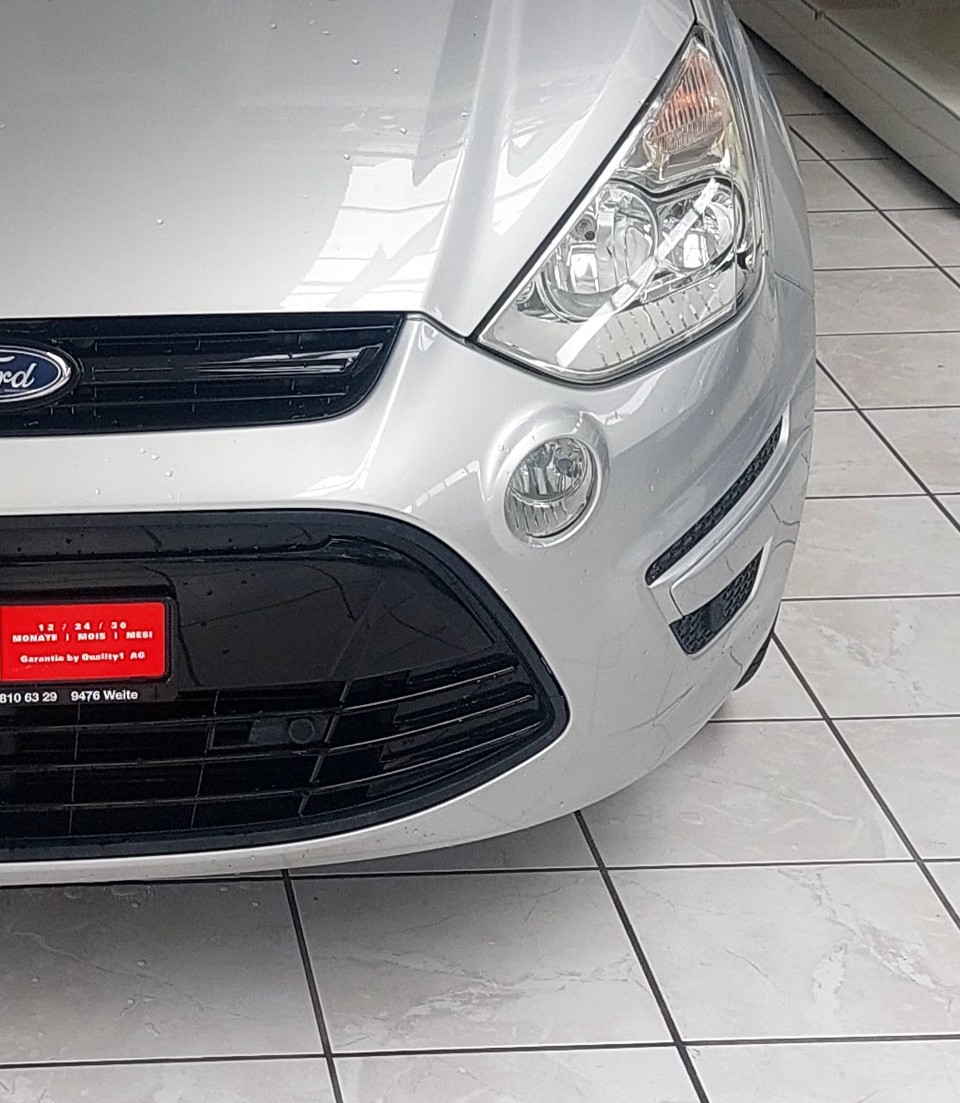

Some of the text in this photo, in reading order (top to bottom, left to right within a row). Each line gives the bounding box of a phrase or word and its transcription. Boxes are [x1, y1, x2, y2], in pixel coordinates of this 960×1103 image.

[12, 633, 58, 642] MONATE
[77, 632, 106, 641] MOIS
[126, 631, 153, 639] MESI
[20, 651, 146, 663] Garantie by Quality1 AG
[0, 693, 22, 704] 810
[24, 692, 40, 702] 63
[42, 692, 58, 702] 29
[70, 690, 101, 702] 9476
[103, 689, 139, 700] Weite
